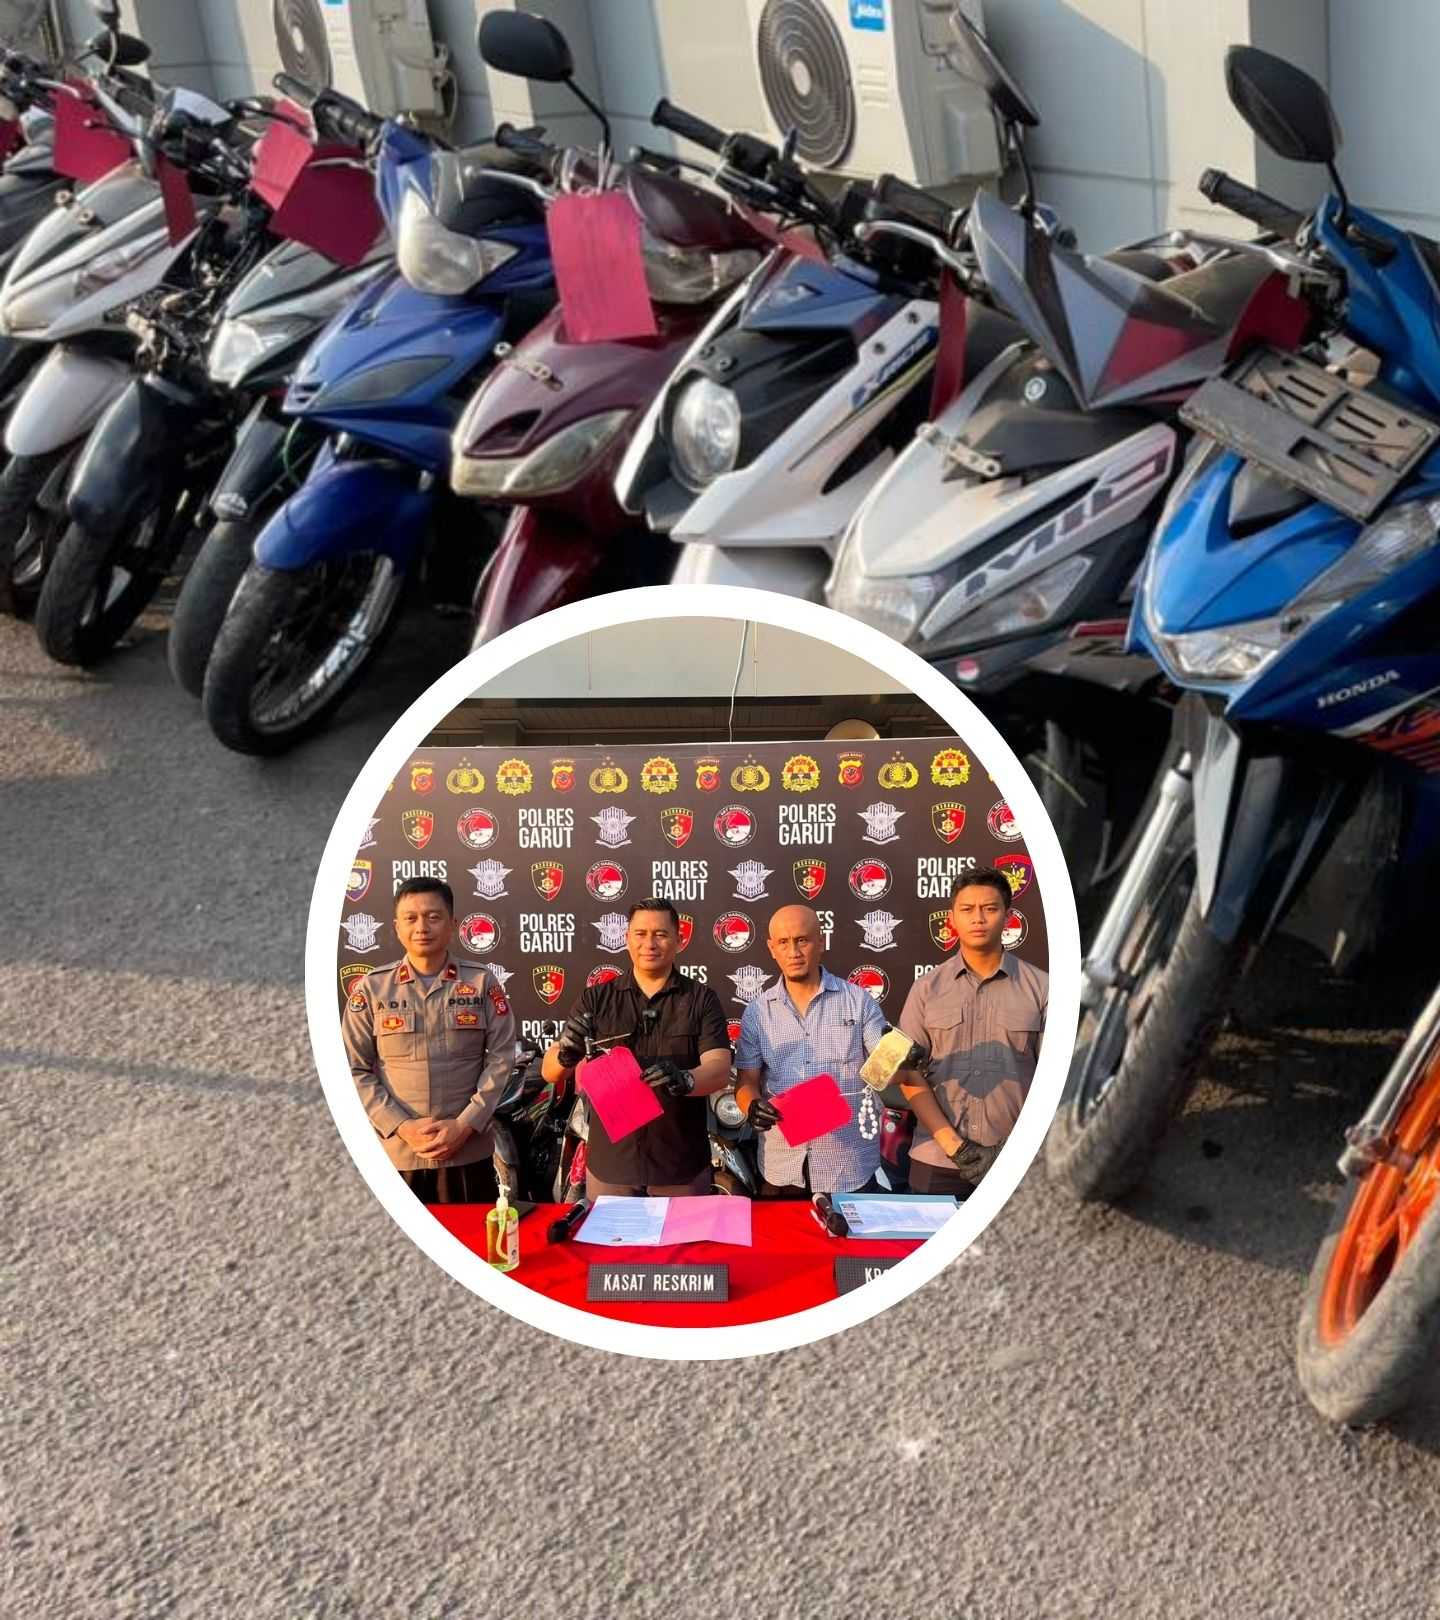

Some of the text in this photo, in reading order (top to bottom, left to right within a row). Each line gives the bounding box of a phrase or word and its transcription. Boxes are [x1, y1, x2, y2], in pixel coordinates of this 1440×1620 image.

[1317, 669, 1400, 709] HONDA
[518, 808, 575, 828] POLRES
[778, 803, 837, 824] POLRES
[518, 827, 574, 849] GARUT
[778, 823, 836, 846] GARUT
[391, 860, 448, 879] POLRES
[652, 860, 708, 880] POLRES
[652, 879, 708, 901] GARUT
[917, 877, 952, 899] GAR
[519, 913, 575, 933] POLRES
[520, 932, 575, 953] GARUT
[448, 997, 485, 1007] POLRI
[603, 1273, 715, 1292] KASAT RESKRIM
